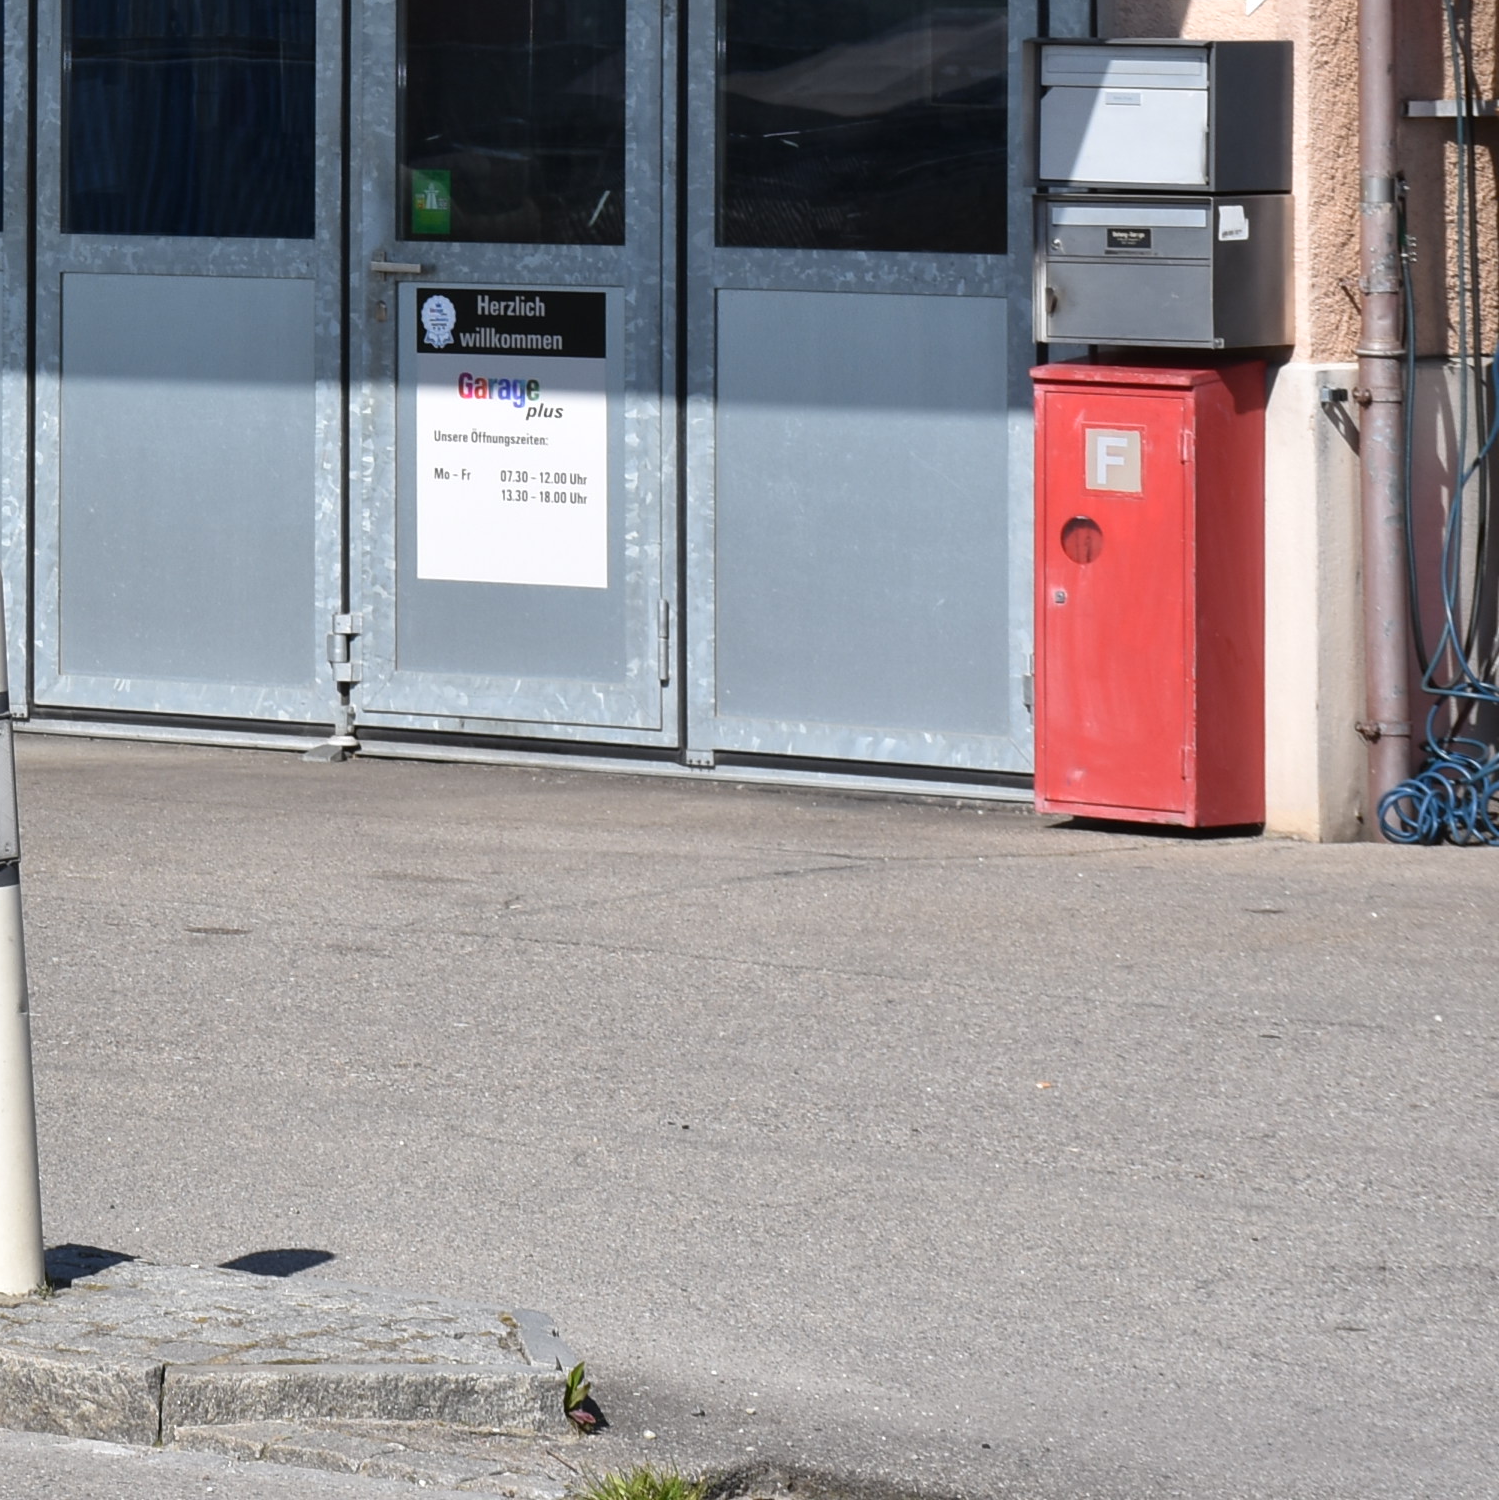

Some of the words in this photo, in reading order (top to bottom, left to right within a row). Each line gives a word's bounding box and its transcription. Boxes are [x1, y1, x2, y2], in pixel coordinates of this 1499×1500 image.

[477, 295, 546, 318] Herzlich
[459, 328, 563, 350] willkommen
[458, 372, 540, 408] Garage
[525, 402, 564, 421] plus
[434, 430, 468, 443] Unsere
[471, 428, 549, 447] Öffnungszeiten:
[1097, 436, 1128, 484] F
[434, 467, 450, 480] Mo
[461, 469, 471, 481] Fr
[500, 470, 529, 483] 07.30
[539, 471, 567, 485] 12.00
[570, 472, 588, 485] Uhr
[501, 489, 529, 502] 13.30
[539, 490, 567, 504] 18.00
[570, 492, 588, 505] Uhr
